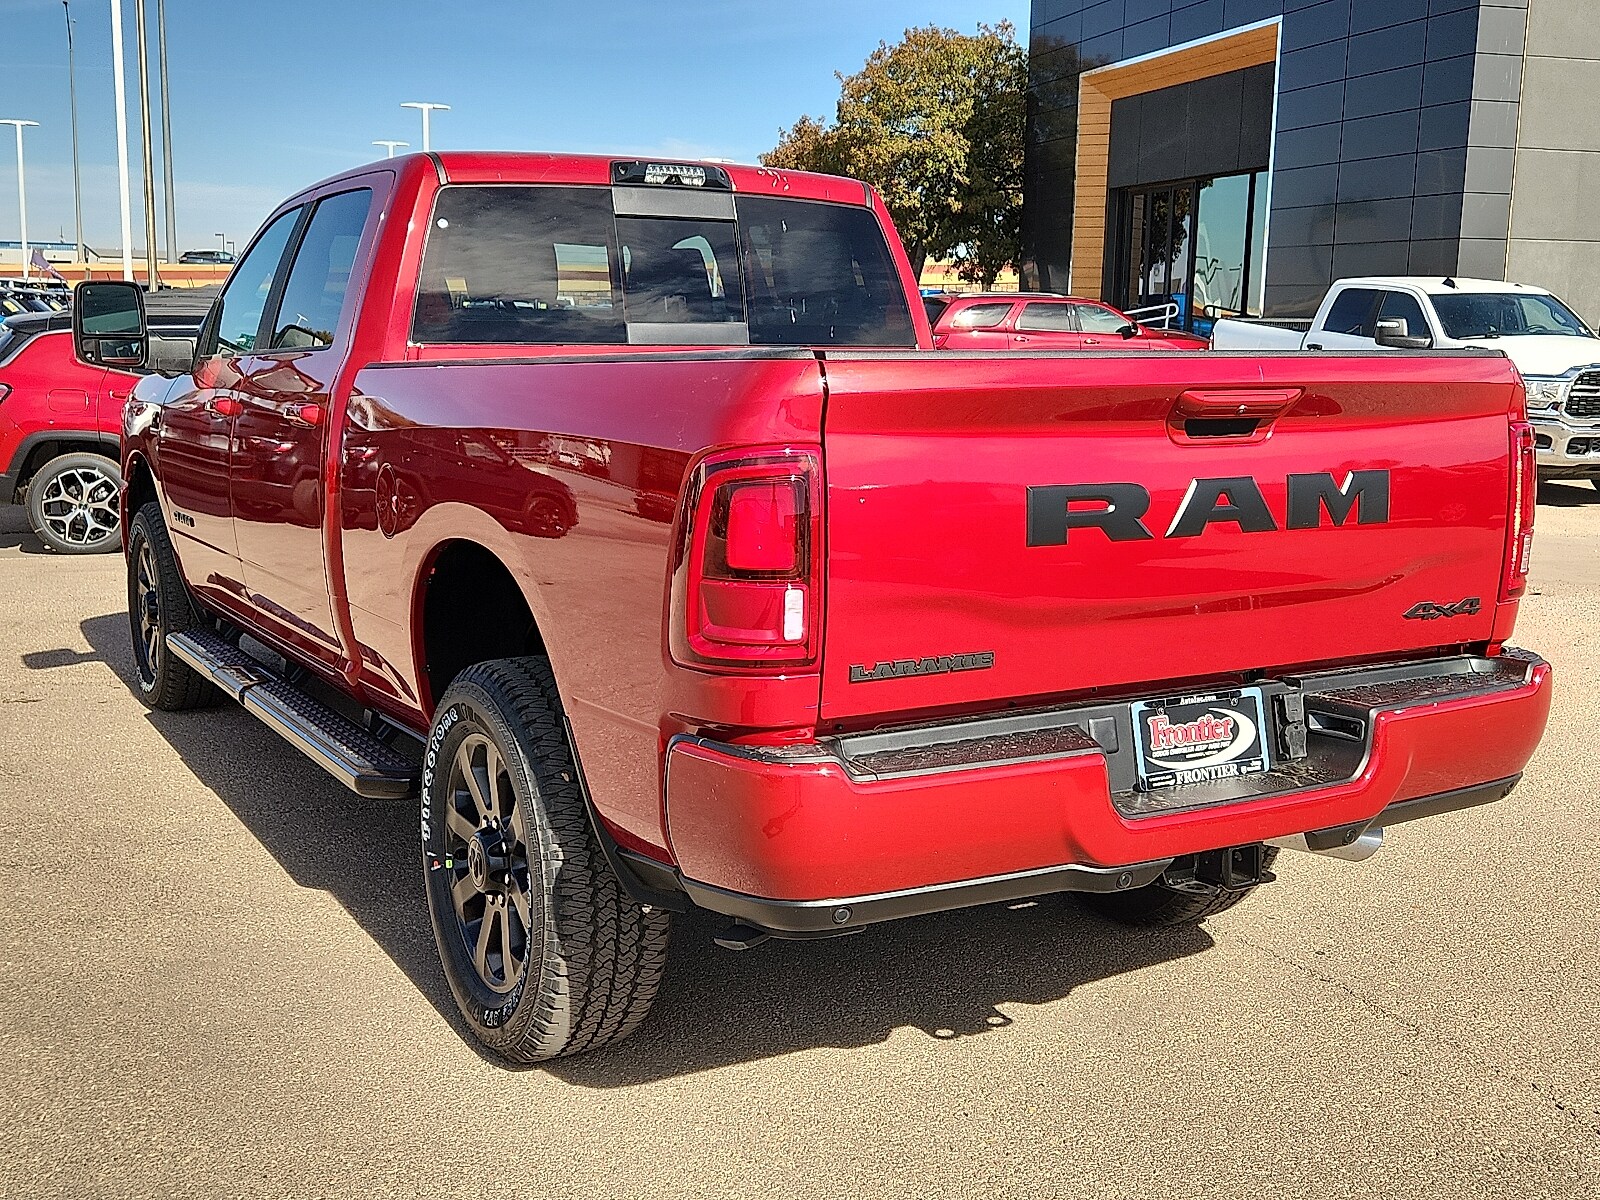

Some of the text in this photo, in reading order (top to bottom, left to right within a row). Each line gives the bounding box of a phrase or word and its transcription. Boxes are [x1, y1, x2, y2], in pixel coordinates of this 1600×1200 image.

[1026, 470, 1390, 547] RAM
[849, 651, 995, 684] LARAMIE
[1148, 714, 1233, 749] Frontier
[1175, 764, 1239, 784] FRONTIER
